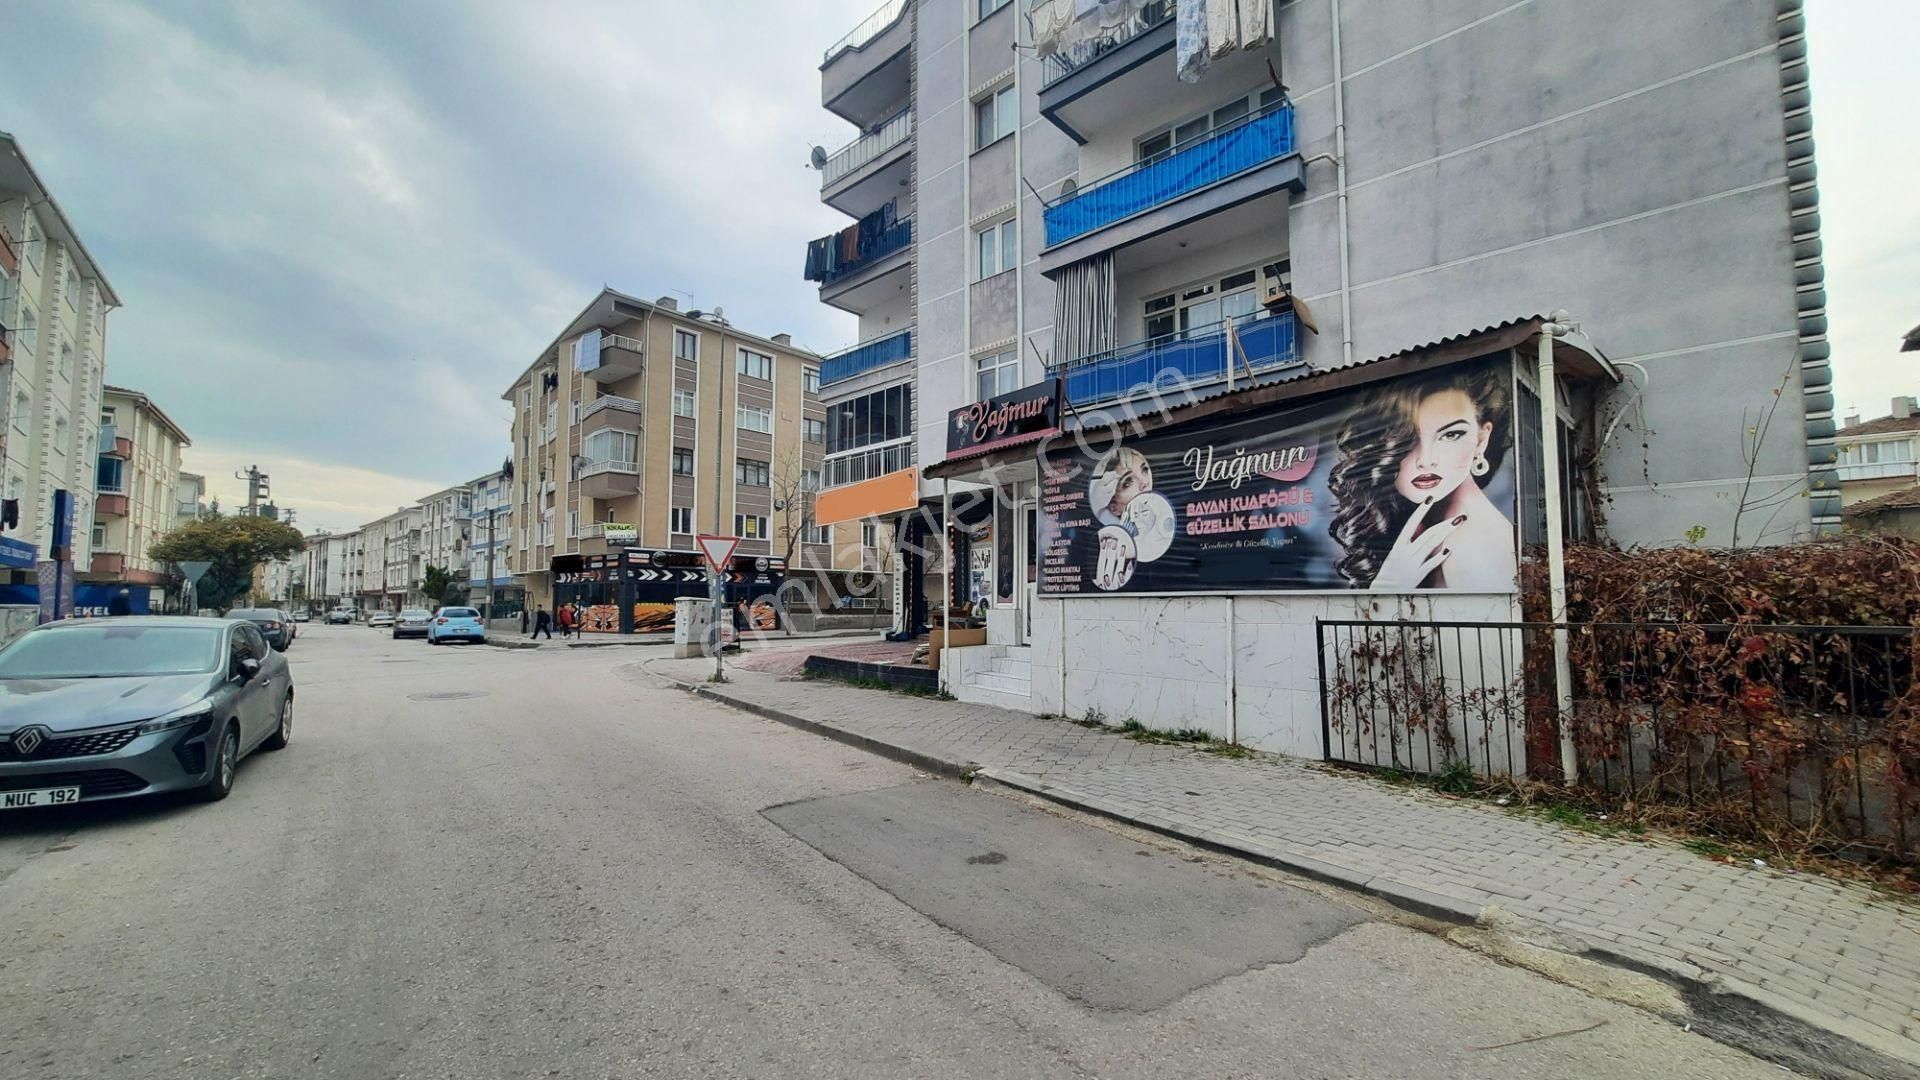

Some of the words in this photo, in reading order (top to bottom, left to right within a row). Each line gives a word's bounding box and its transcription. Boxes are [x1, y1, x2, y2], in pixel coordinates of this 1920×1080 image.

[968, 399, 1049, 442] Yağmur
[1183, 444, 1308, 491] Yağmur
[1186, 498, 1228, 517] BAYAN
[1230, 487, 1301, 513] KUAFÖRÜ
[1186, 513, 1247, 536] GÜZELLİK
[1249, 509, 1310, 530] SALONU
[74, 606, 110, 616] EKEL
[5, 792, 37, 807] NUC
[48, 788, 76, 803] 192
